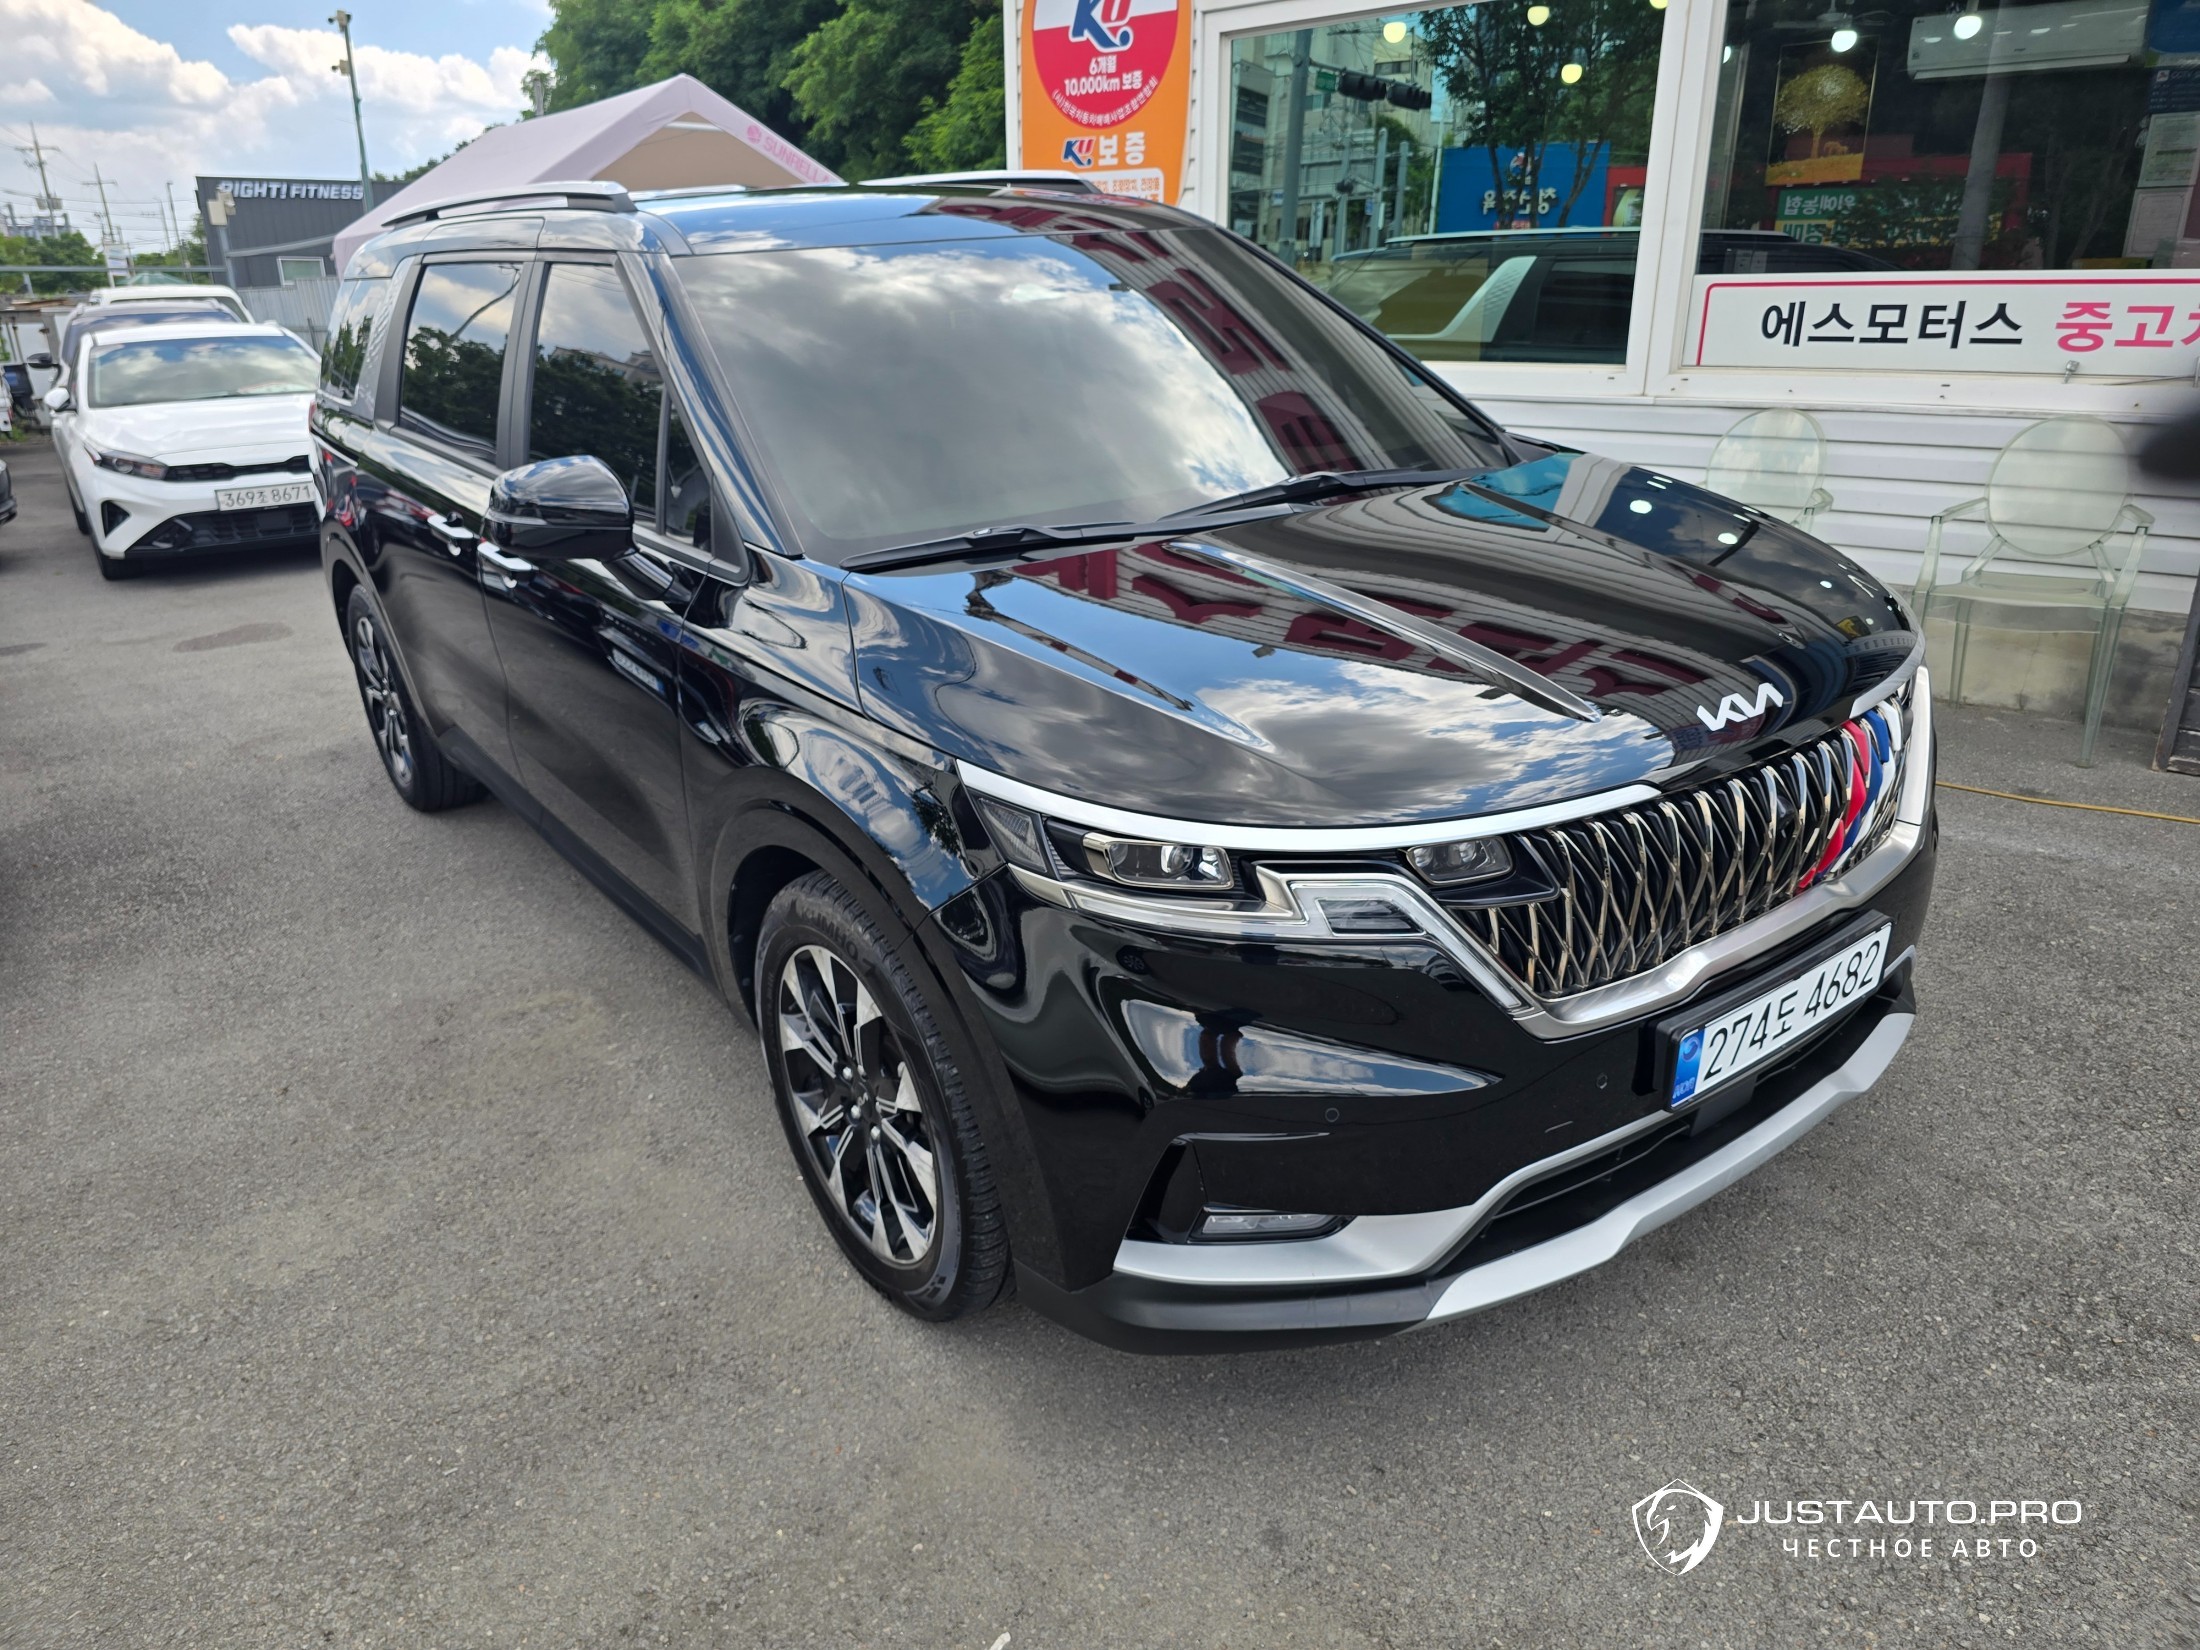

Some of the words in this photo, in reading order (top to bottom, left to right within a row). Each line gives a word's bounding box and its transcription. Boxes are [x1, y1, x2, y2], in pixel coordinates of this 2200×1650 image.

[1089, 55, 1117, 75] 6개월
[1064, 76, 1120, 97] 10,000km
[1122, 70, 1143, 91] 보증
[1098, 132, 1146, 166] 보증
[290, 183, 364, 200] FITNESS
[1761, 300, 2023, 349] 에스모터스
[272, 485, 311, 503] 8671
[1704, 989, 1799, 1081] 274도
[1804, 940, 1881, 1018] 4682
